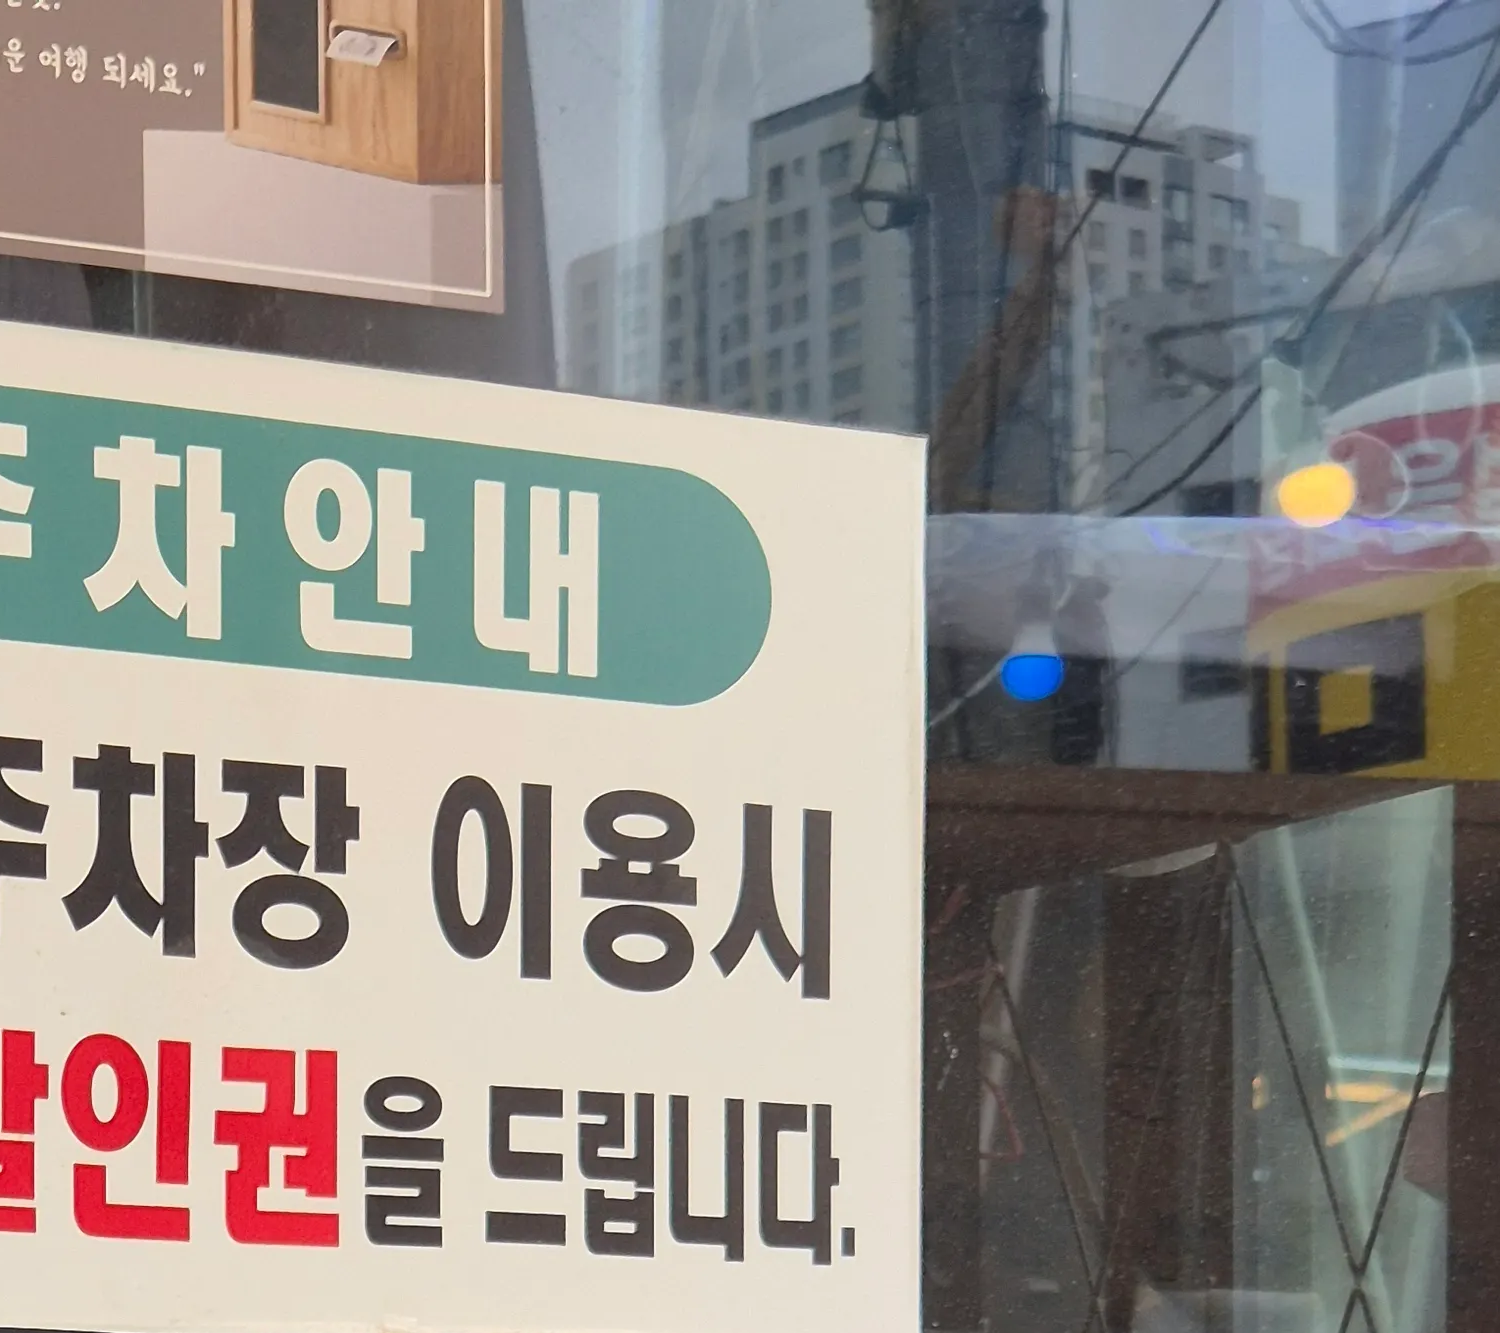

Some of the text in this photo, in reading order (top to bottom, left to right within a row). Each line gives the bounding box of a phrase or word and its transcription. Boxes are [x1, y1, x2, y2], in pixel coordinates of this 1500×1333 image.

[38, 43, 88, 84] 여행
[102, 52, 206, 98] 되세요."
[431, 775, 834, 1000] 이용시
[485, 1085, 858, 1265] 드립니다.
